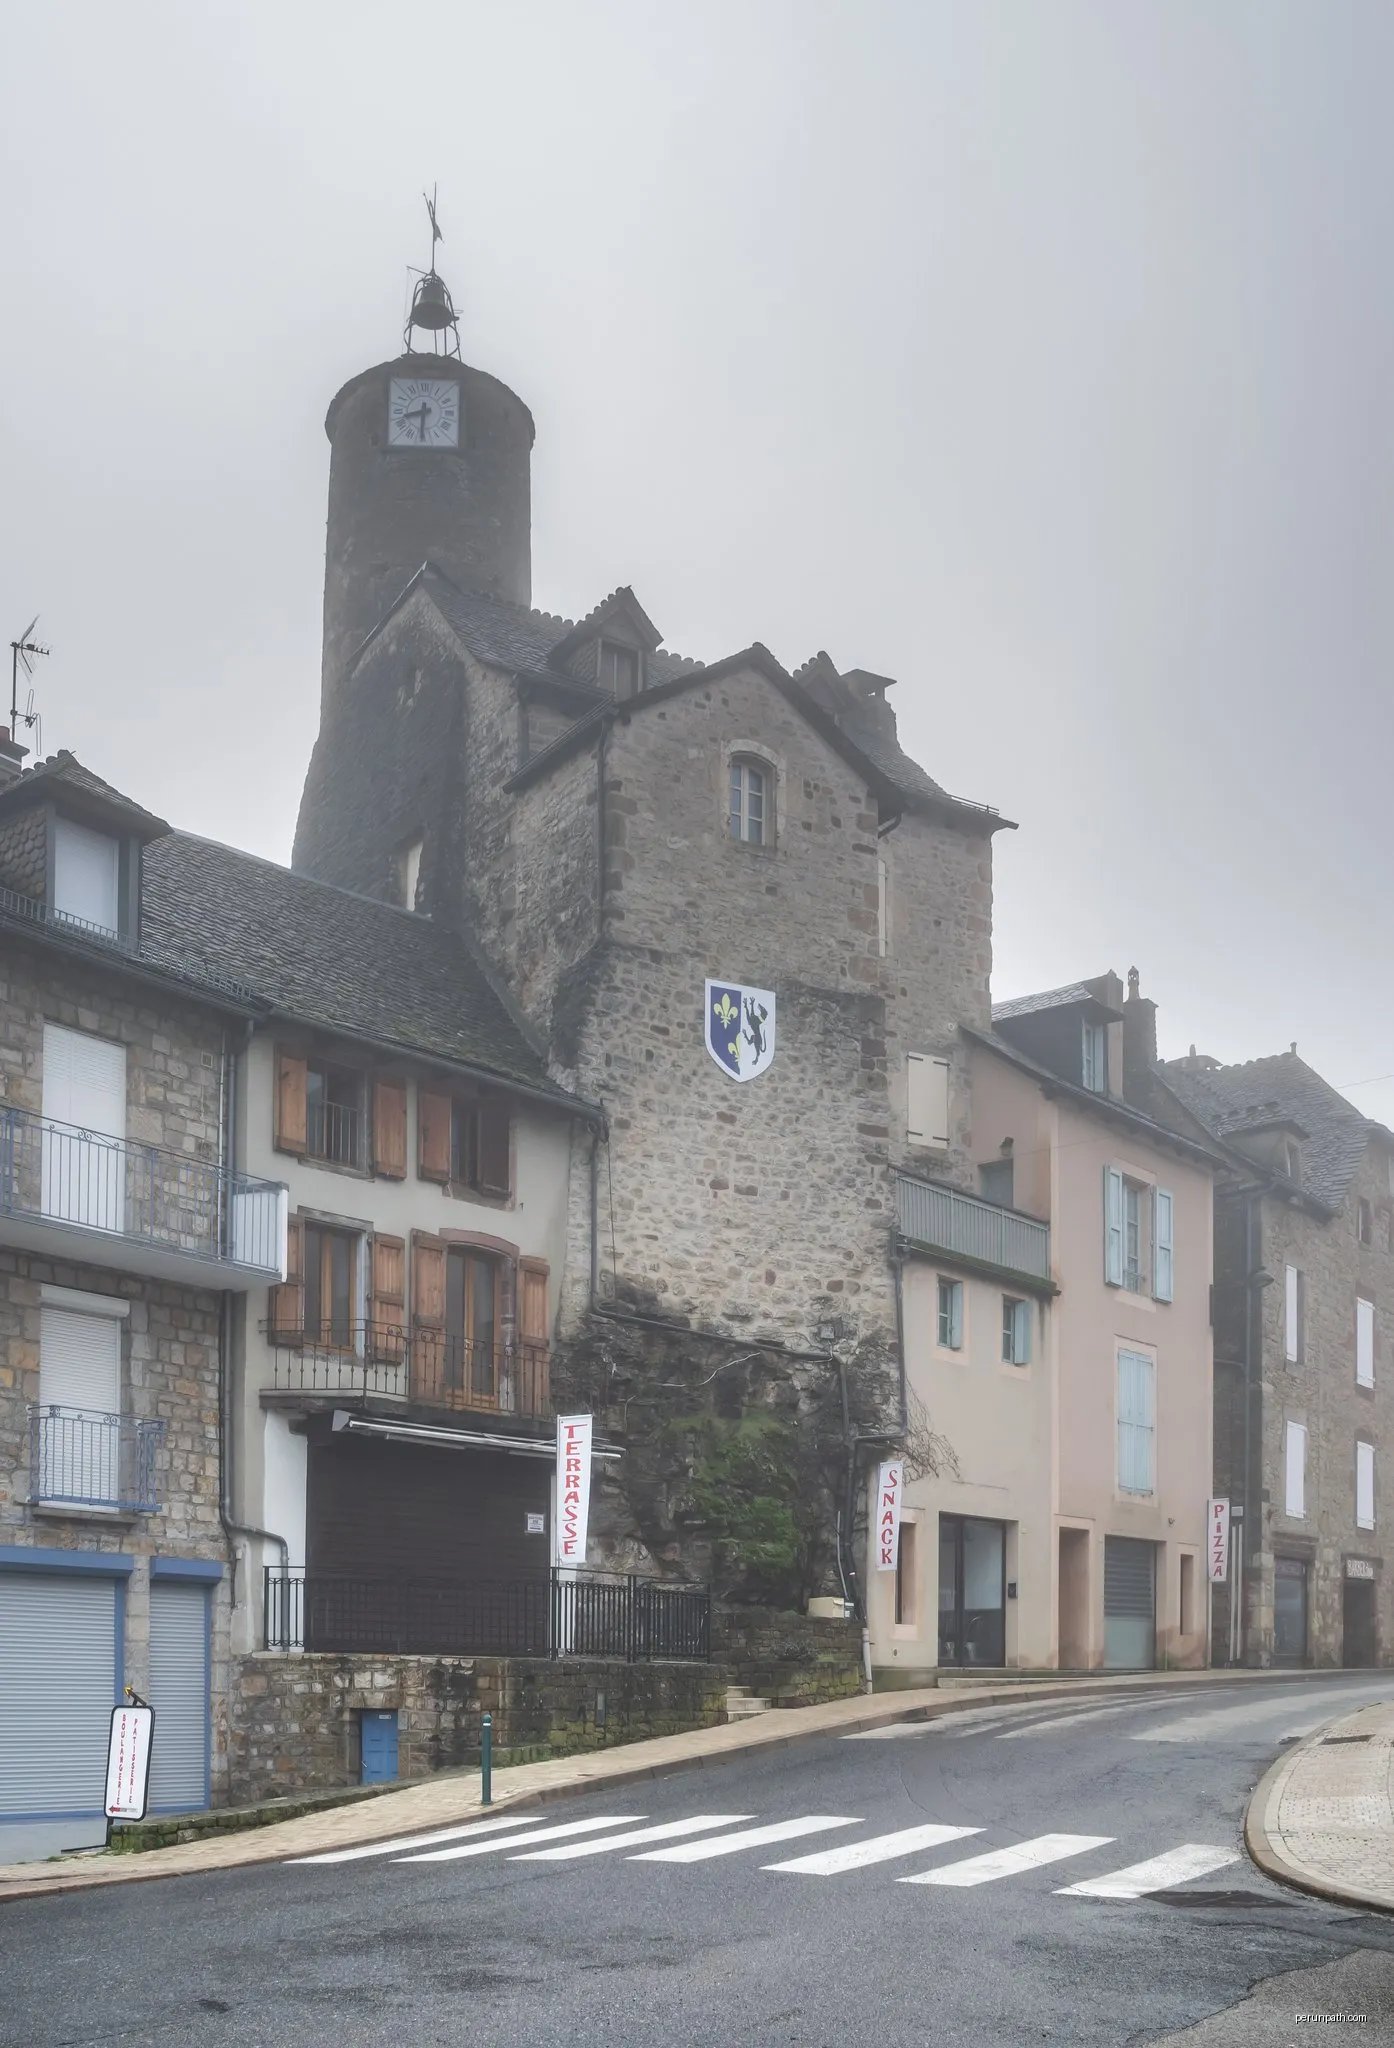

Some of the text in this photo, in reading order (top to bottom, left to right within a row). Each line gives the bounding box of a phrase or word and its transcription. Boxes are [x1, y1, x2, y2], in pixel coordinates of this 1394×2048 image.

[562, 1424, 587, 1555] TERRASSE
[881, 1469, 898, 1564] SNACK
[116, 1714, 127, 1805] BOULANGERIE
[129, 1718, 138, 1804] PATISSERIE
